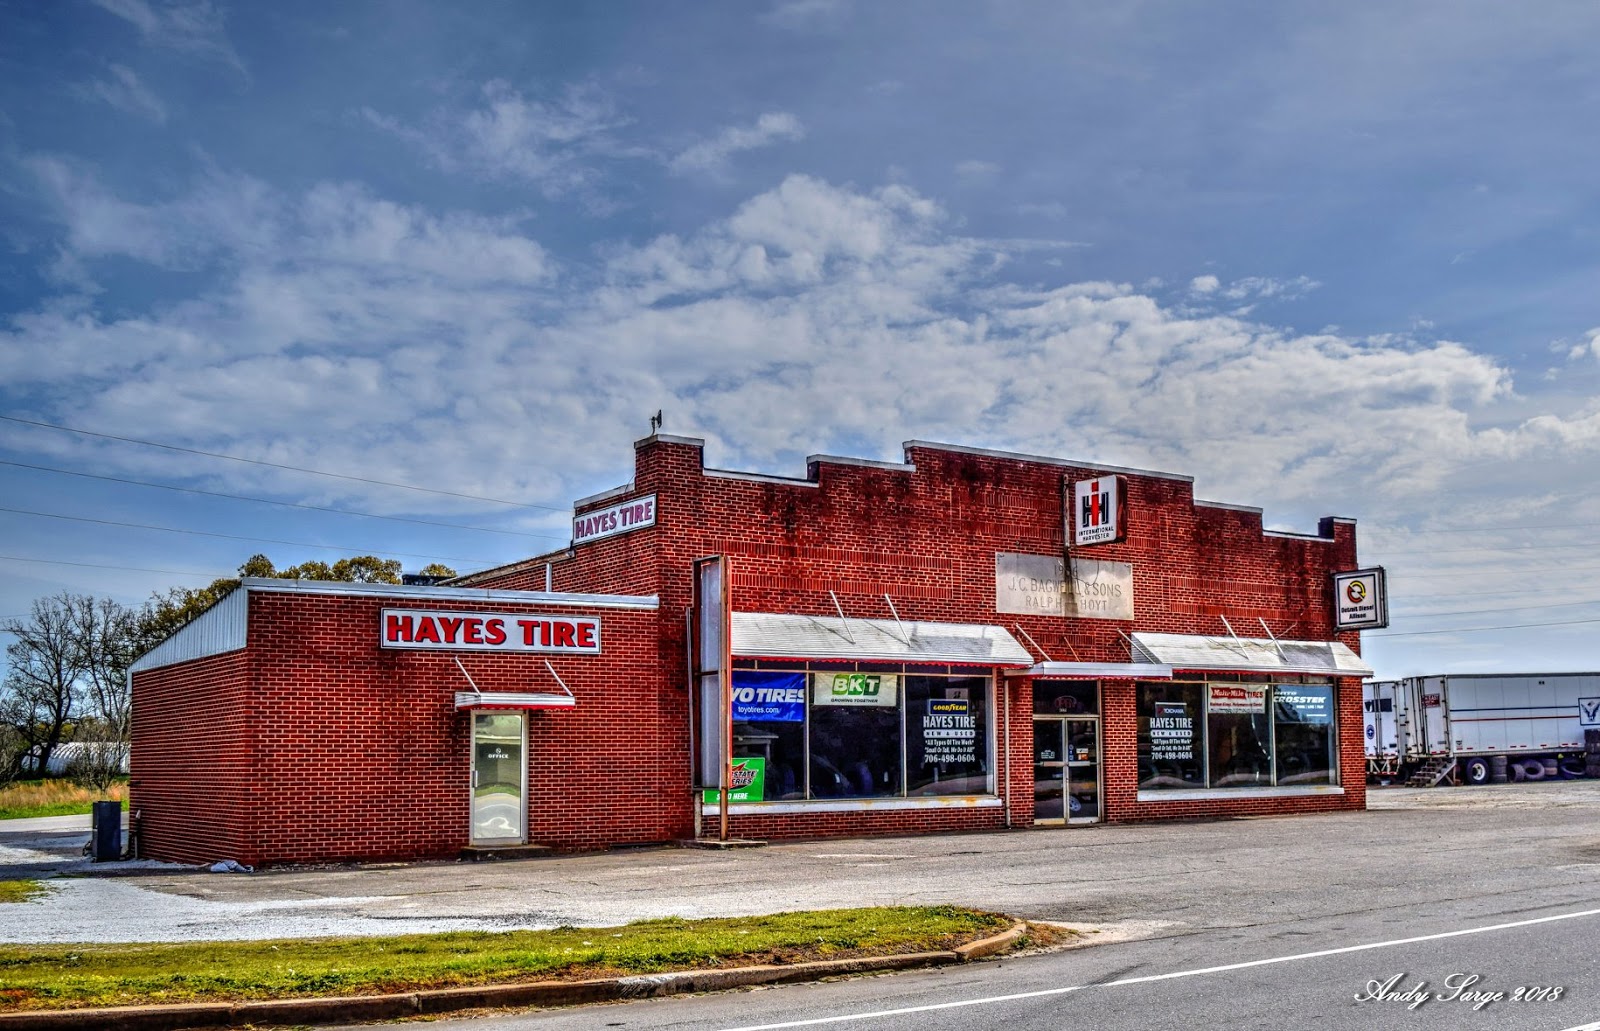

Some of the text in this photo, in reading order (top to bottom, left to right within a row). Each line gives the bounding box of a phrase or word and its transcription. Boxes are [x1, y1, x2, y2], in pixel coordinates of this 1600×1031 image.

[575, 501, 652, 539] HAYES TIRE
[1079, 526, 1114, 536] INTERNATIONAL
[1083, 533, 1109, 541] HARVESTER
[1084, 582, 1091, 595] &
[1093, 583, 1121, 597] SONS
[1025, 595, 1107, 612] RALPH HOYT
[1341, 605, 1358, 613] Detroit
[387, 615, 596, 648] HAYES TIRE
[833, 677, 880, 695] BKT
[738, 706, 780, 715] toyotires.com
[923, 716, 976, 728] HAYES TIRE
[1150, 718, 1193, 728] HAYES TIRE
[924, 754, 975, 763] 706-498-0604
[1151, 752, 1192, 760] 706-498-0604
[733, 792, 748, 800] HERE
